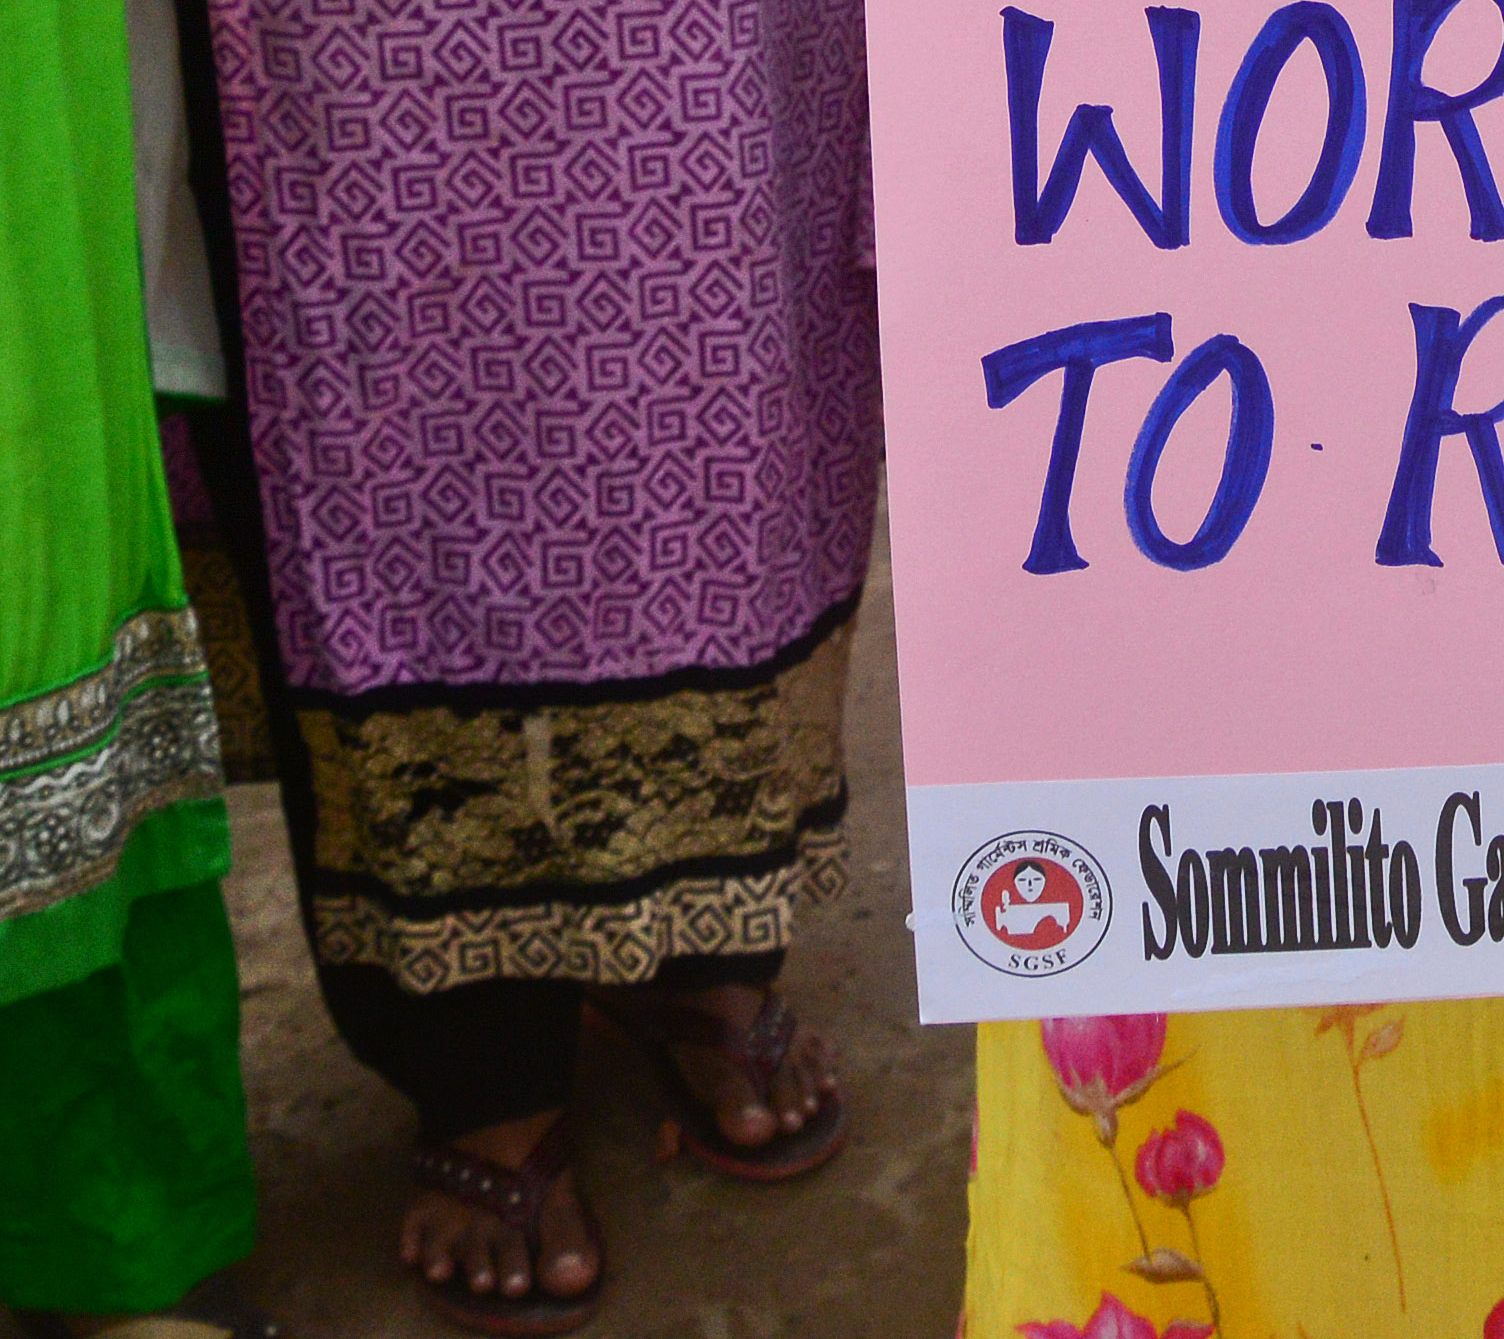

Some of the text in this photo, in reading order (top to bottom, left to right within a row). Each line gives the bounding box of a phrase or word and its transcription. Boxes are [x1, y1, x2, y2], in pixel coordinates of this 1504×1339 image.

[981, 311, 1276, 575] TO
[1008, 948, 1067, 972] SGSF
[1138, 797, 1422, 961] Sommilito
